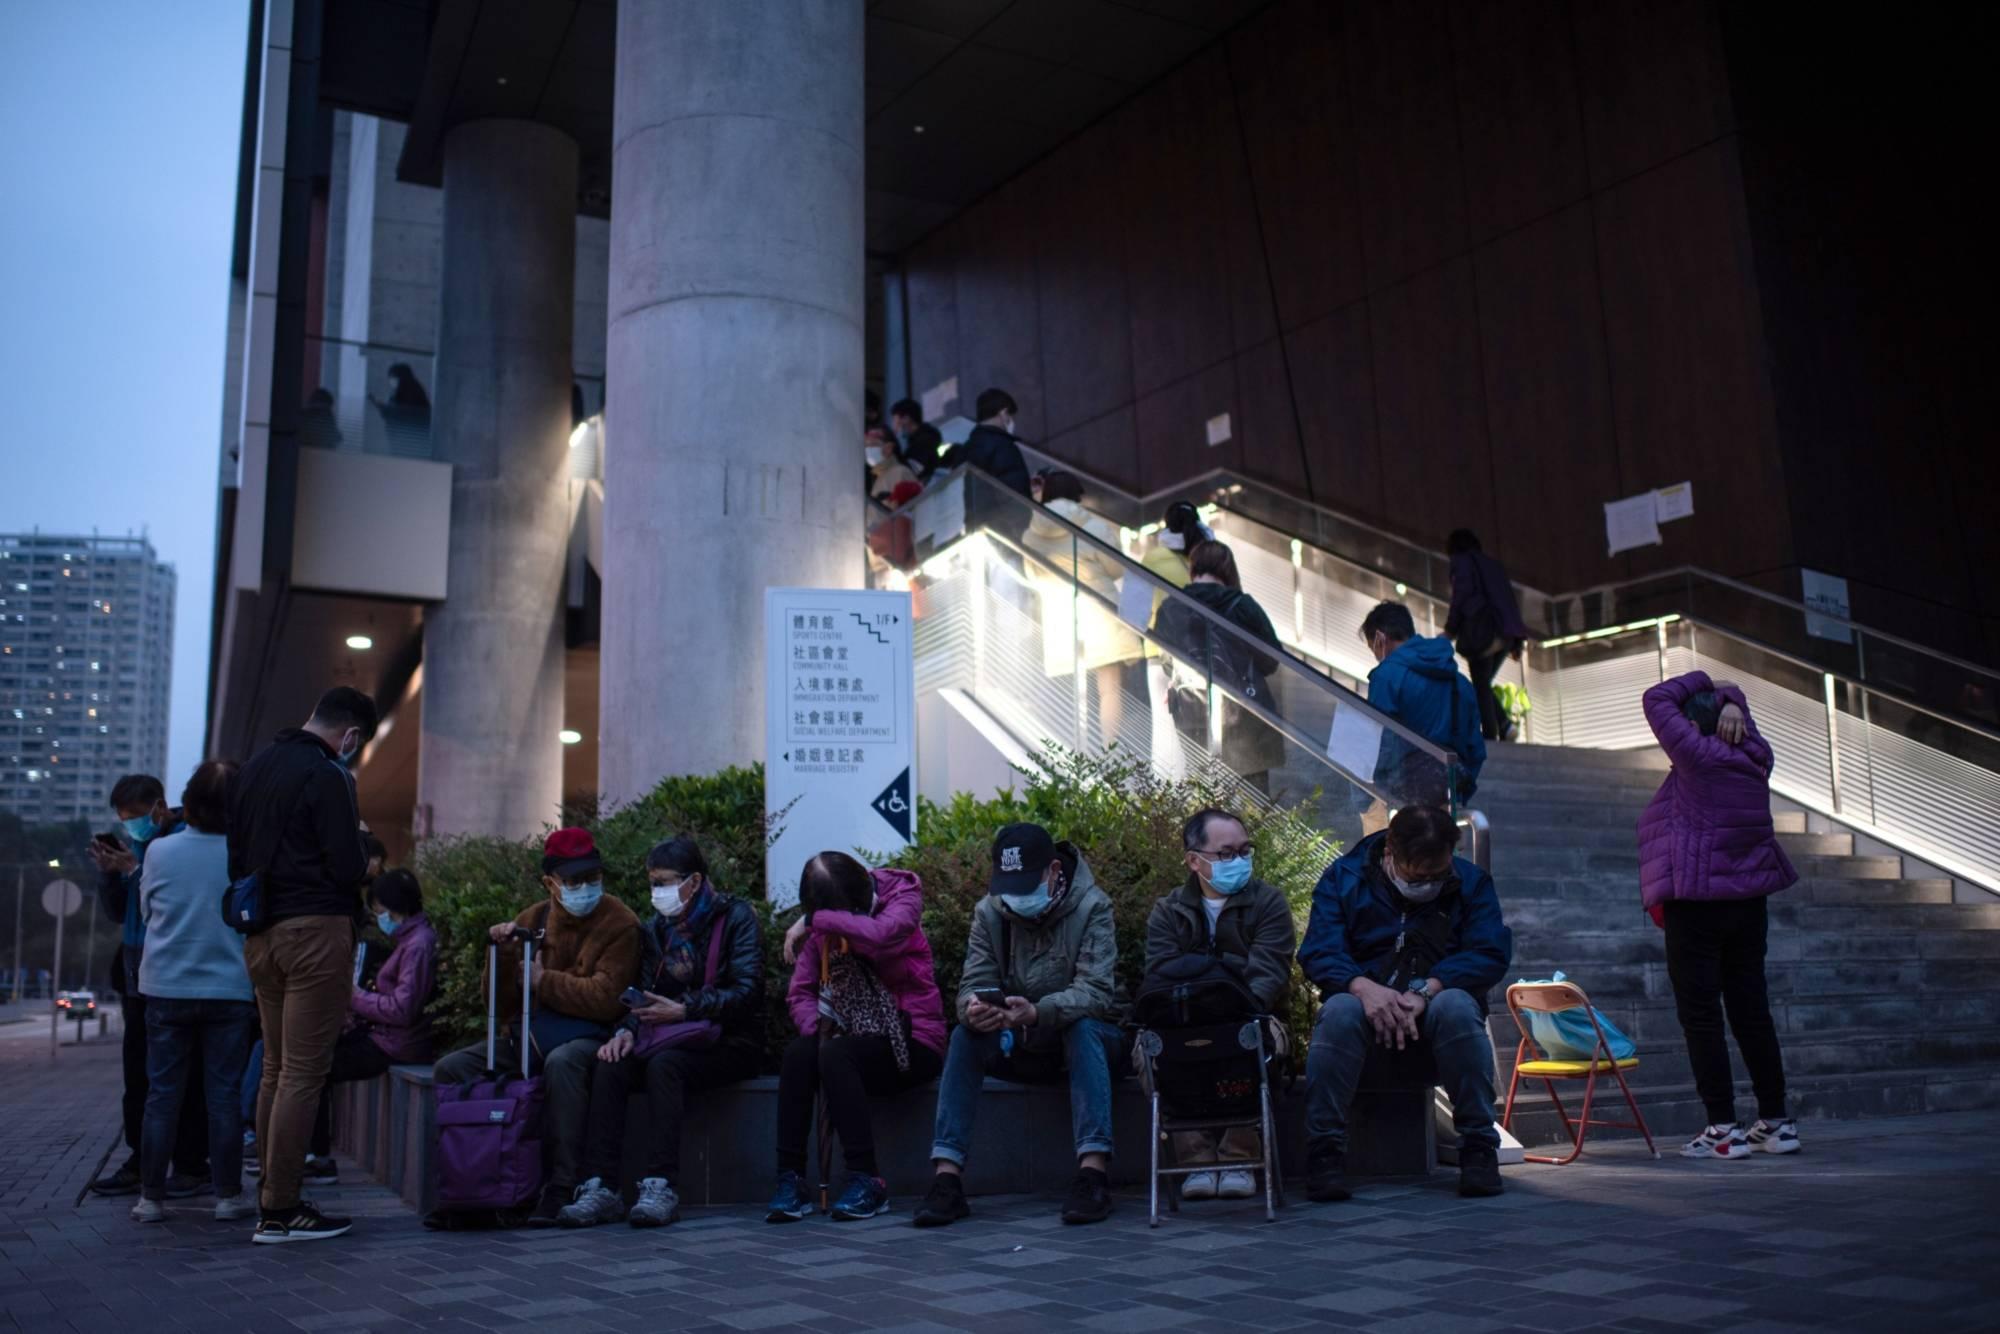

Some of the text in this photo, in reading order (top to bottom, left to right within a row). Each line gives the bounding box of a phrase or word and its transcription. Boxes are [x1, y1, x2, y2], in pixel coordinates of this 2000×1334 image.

[793, 615, 834, 630] 體育館
[876, 614, 890, 625] 1/F
[793, 631, 818, 640] SPORTS
[794, 645, 848, 660] 社區會堂
[793, 662, 848, 671] COMMUNITY HALL
[794, 677, 863, 692] 入境事務處
[794, 694, 880, 703] IMMIGRATION DEPARTMENT
[794, 710, 863, 725] 社會福利署
[794, 727, 890, 736] SOCIAL WELFARE DEPARTMENT
[795, 748, 864, 763] 婚姻登記處
[794, 764, 859, 773] MARRIAGE REGISTRY
